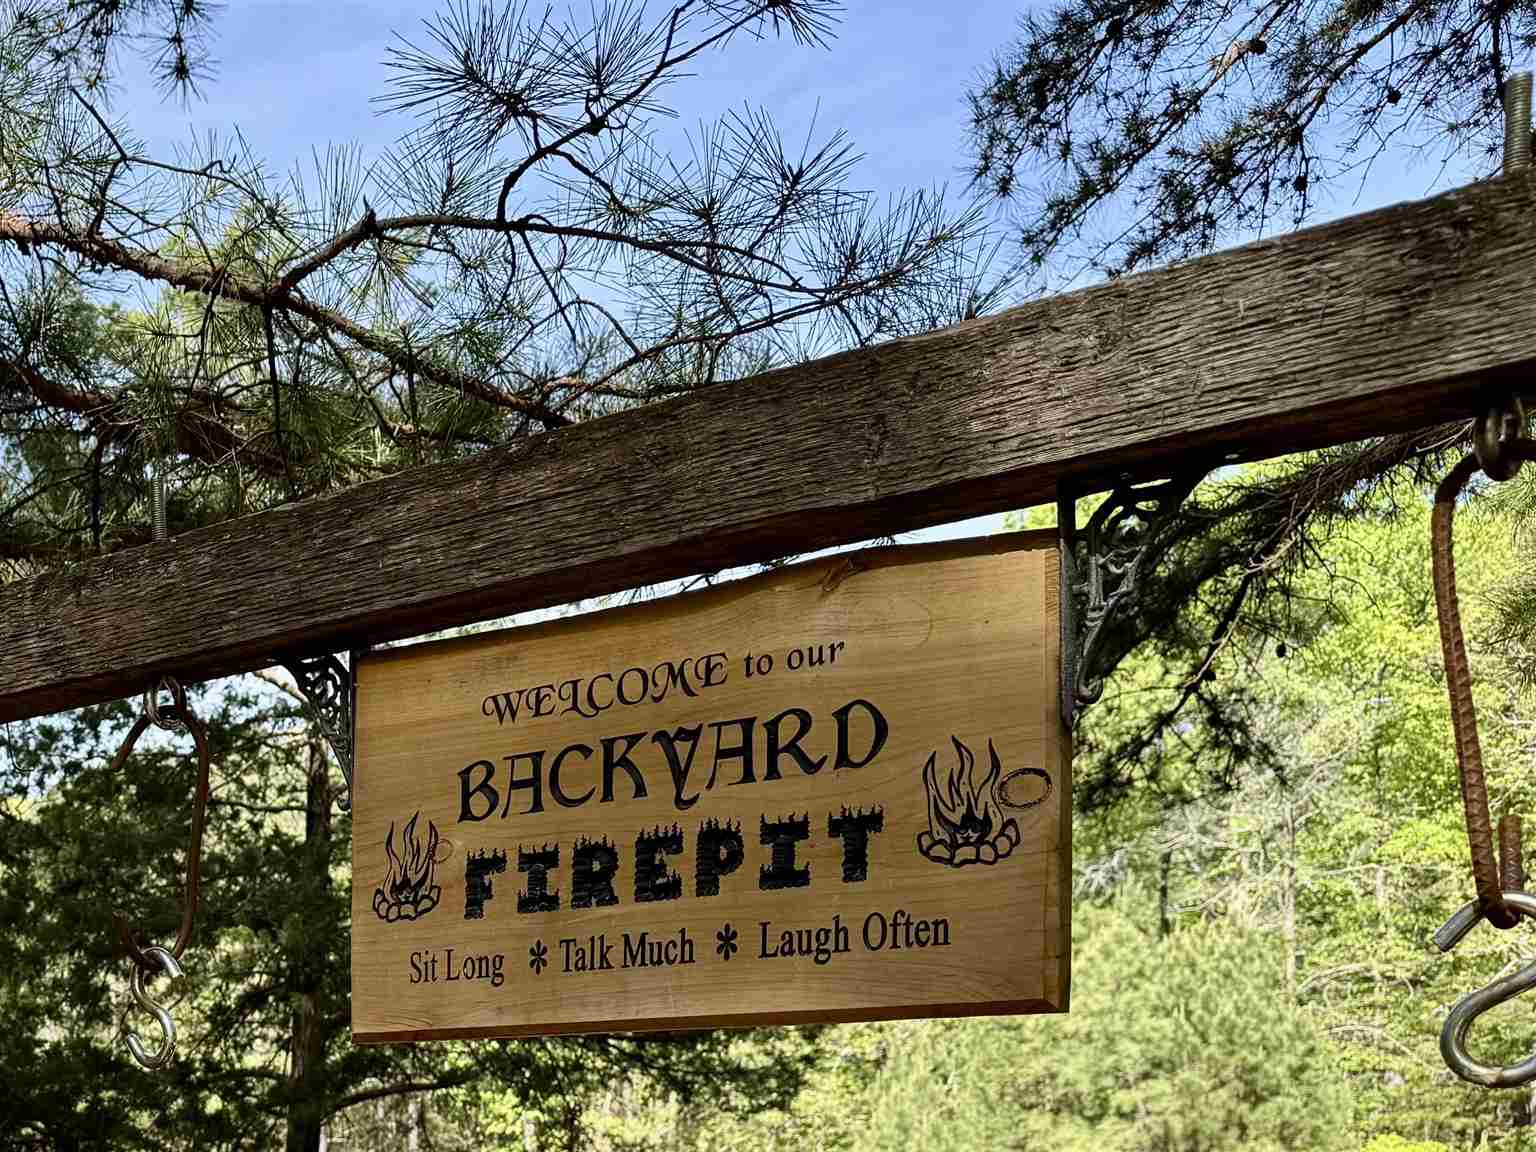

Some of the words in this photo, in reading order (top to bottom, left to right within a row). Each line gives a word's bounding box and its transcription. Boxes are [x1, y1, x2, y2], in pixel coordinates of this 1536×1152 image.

[482, 653, 728, 726] WELCOME
[744, 653, 774, 679] to
[787, 641, 845, 671] our
[457, 698, 889, 823] BACKYARD
[462, 801, 886, 921] FIREPIT
[409, 951, 439, 984] Sit
[445, 948, 505, 988] Long
[559, 934, 614, 973] Talk
[621, 928, 695, 969] Much
[758, 920, 851, 966] Laugh
[863, 909, 951, 952] Often
